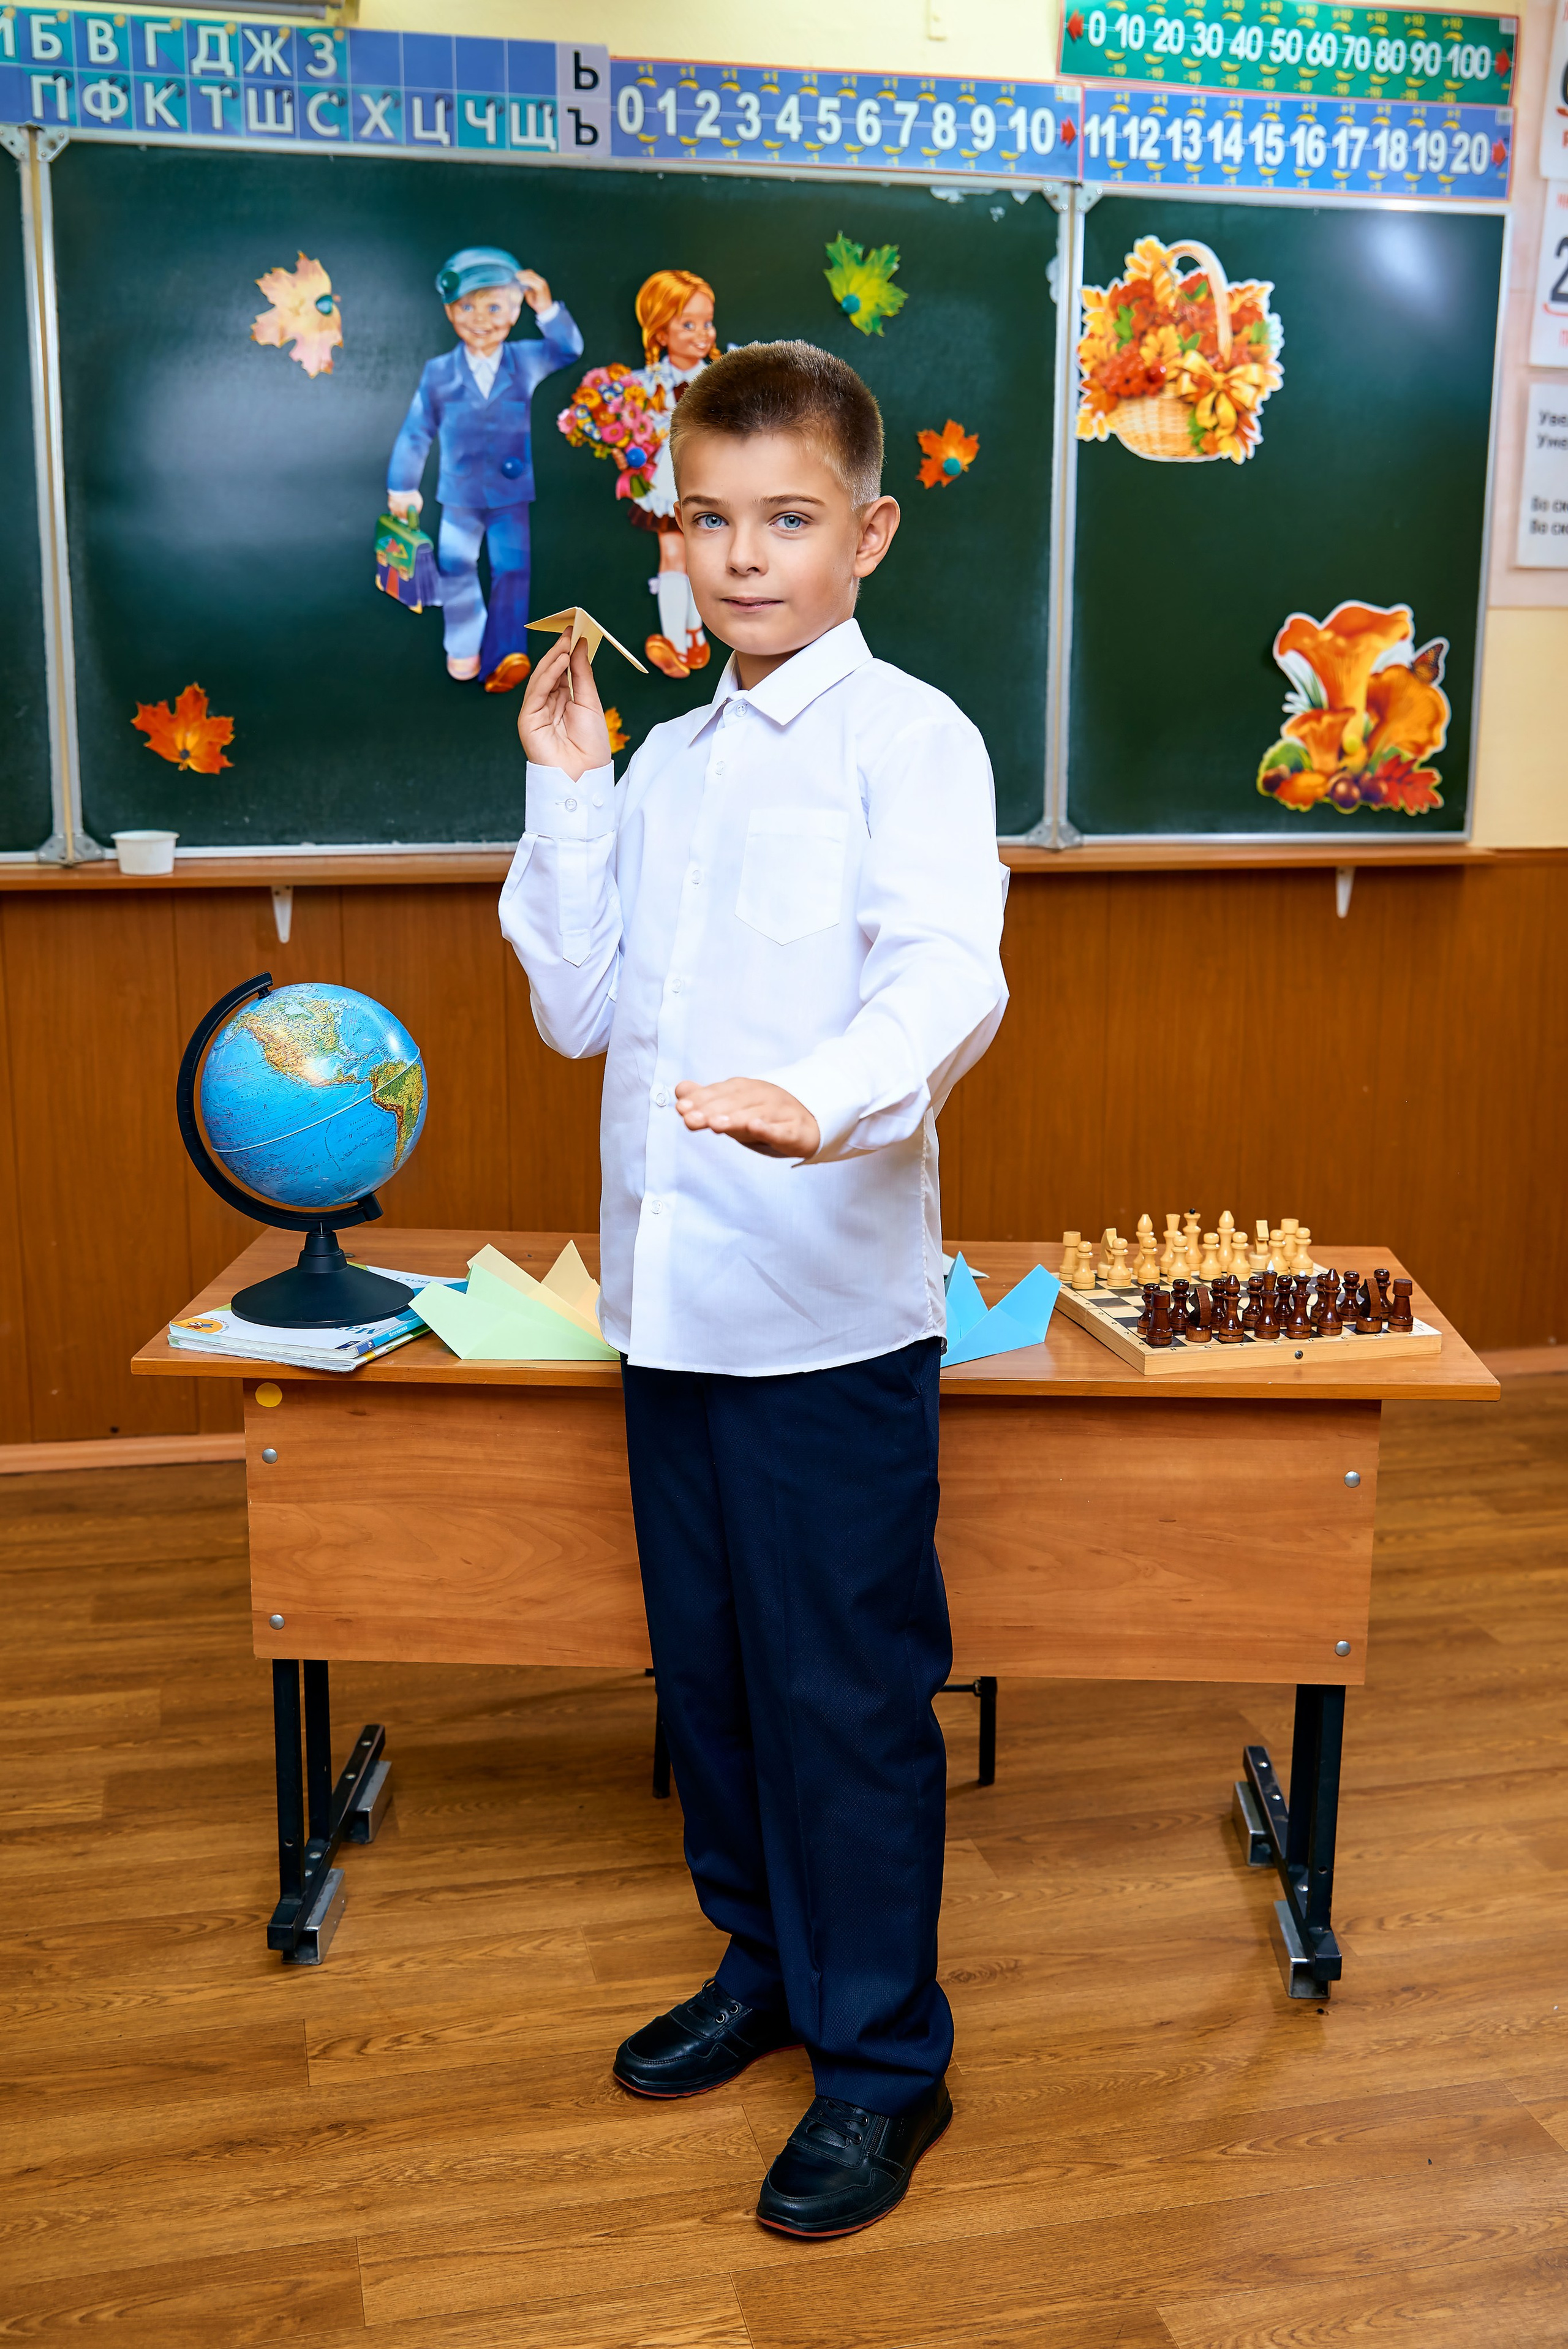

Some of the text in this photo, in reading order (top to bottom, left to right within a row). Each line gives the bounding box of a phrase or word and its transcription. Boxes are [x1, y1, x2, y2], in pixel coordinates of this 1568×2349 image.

[29, 14, 62, 61] Б
[86, 18, 119, 64] В
[144, 22, 174, 68] Г
[190, 25, 235, 78] Д
[242, 28, 293, 77] Ж
[305, 32, 337, 78] З
[573, 50, 600, 91] Ь
[1088, 10, 1492, 81] 0 10 20 30 40 50 60 70 80 90 100
[31, 74, 558, 151] П Ф К Т Ш С Х Ц Ч Щ
[567, 107, 600, 146] Ъ
[617, 85, 1057, 156] 0 1 2 3 4 5 6 7 8 9 10
[1084, 113, 1490, 176] 11 12 13 14 15 16 17 18 19 20
